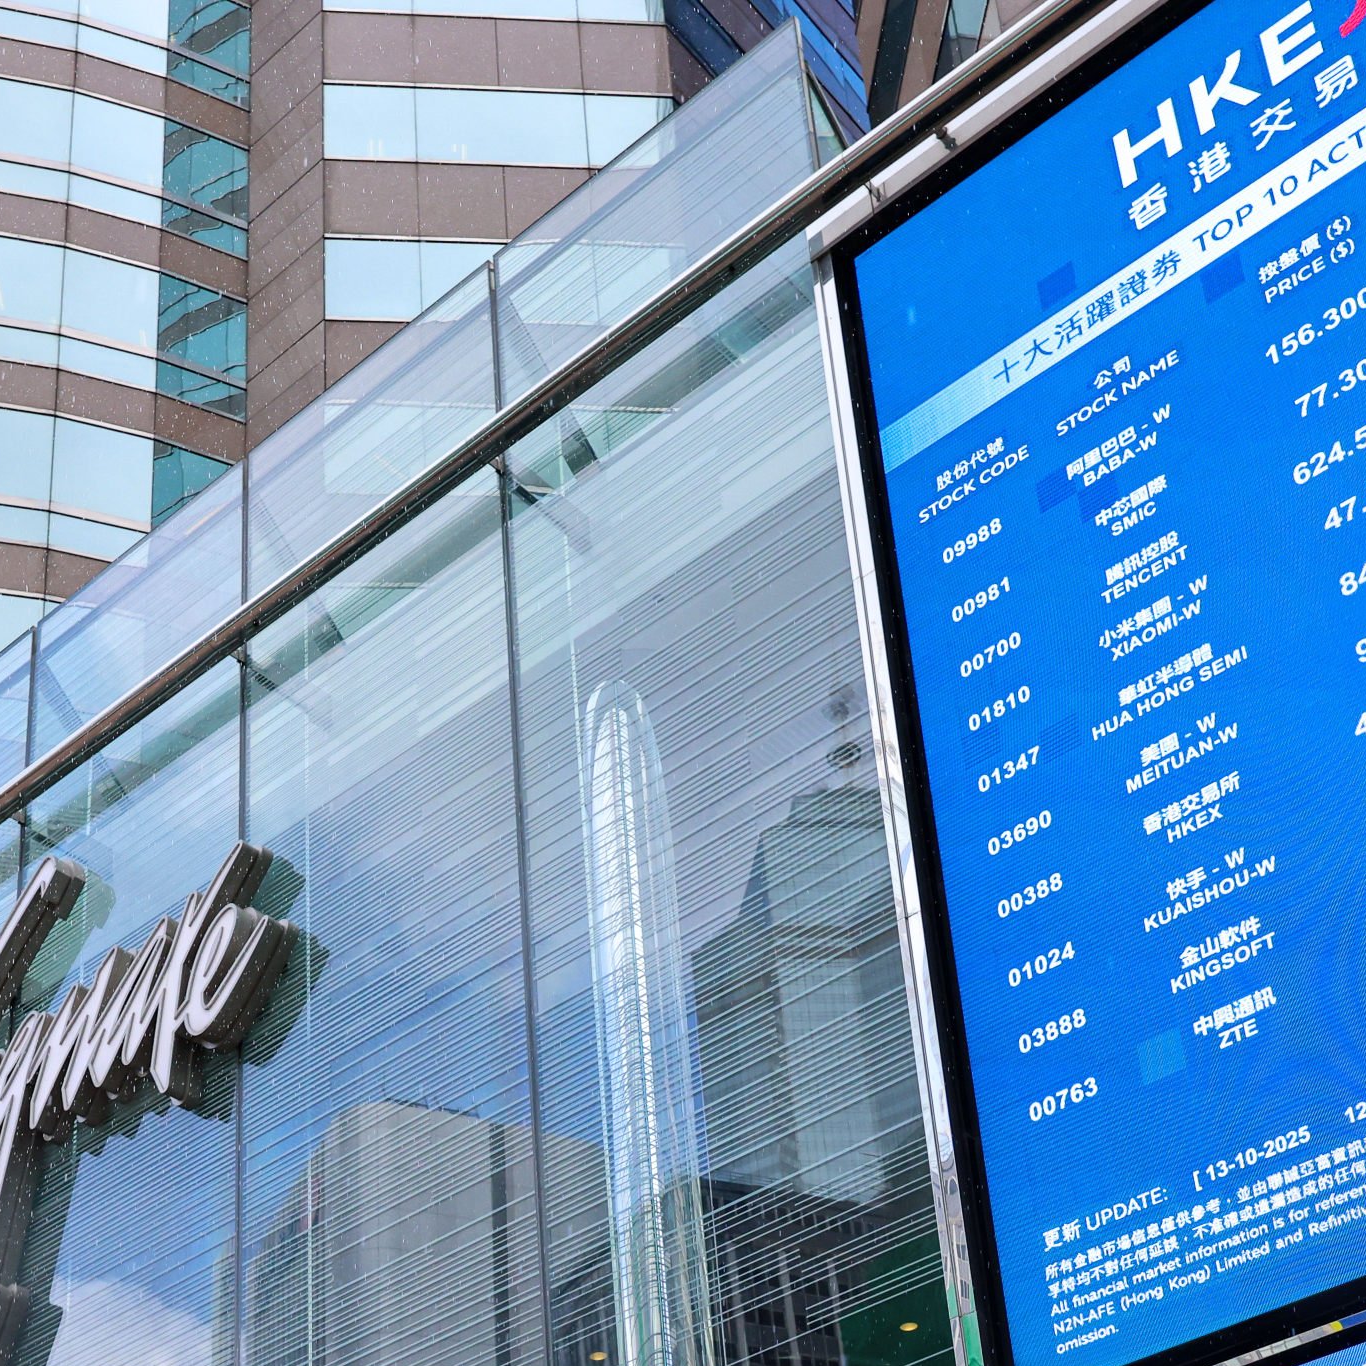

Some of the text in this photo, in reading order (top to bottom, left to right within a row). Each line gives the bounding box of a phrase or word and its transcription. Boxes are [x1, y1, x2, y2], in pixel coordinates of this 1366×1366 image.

[1192, 203, 1254, 253] TOP
[1263, 174, 1299, 207] 10
[1264, 255, 1326, 304] PRICE
[1056, 349, 1179, 437] STOCK NAME
[1093, 355, 1131, 389] 公司
[918, 444, 1030, 524] STOCK CODE
[936, 436, 1005, 492] 股份代號
[1082, 431, 1157, 487] BABA-W
[1095, 474, 1167, 526] 中芯國際
[1111, 501, 1157, 537] SMIC
[942, 517, 1002, 564] 09988
[951, 576, 1011, 623] 00981
[1101, 544, 1188, 604] TENCENT
[960, 631, 1022, 678] 00700
[1111, 599, 1201, 661] XIAOMI-W
[968, 685, 1031, 732] 01810
[1091, 645, 1248, 741] HUA HONG SEMI
[977, 745, 1040, 793] 01347
[1125, 722, 1238, 794] MEITUAN-W
[1143, 771, 1240, 835] 香港交易所
[1166, 803, 1223, 843] HKEX
[987, 809, 1052, 856] 03690
[997, 872, 1063, 919] 00388
[1143, 855, 1276, 933] KUAISHOU-W
[1008, 941, 1075, 987] 01024
[1170, 931, 1275, 994] KINGSOFT
[1179, 915, 1261, 969] 金山軟件
[1018, 1008, 1087, 1054] 03888
[1218, 1018, 1258, 1050] ZTE
[1028, 1076, 1098, 1122] 00763
[1043, 1219, 1081, 1252] 更新
[1085, 1186, 1168, 1232] UPDATE:
[1205, 1124, 1311, 1181] 13-10-2025
[1050, 1299, 1071, 1317] All
[1071, 1276, 1129, 1308] financial
[1132, 1257, 1182, 1285] market
[1184, 1223, 1269, 1264] information
[1272, 1217, 1286, 1230] is
[1288, 1206, 1310, 1224] for
